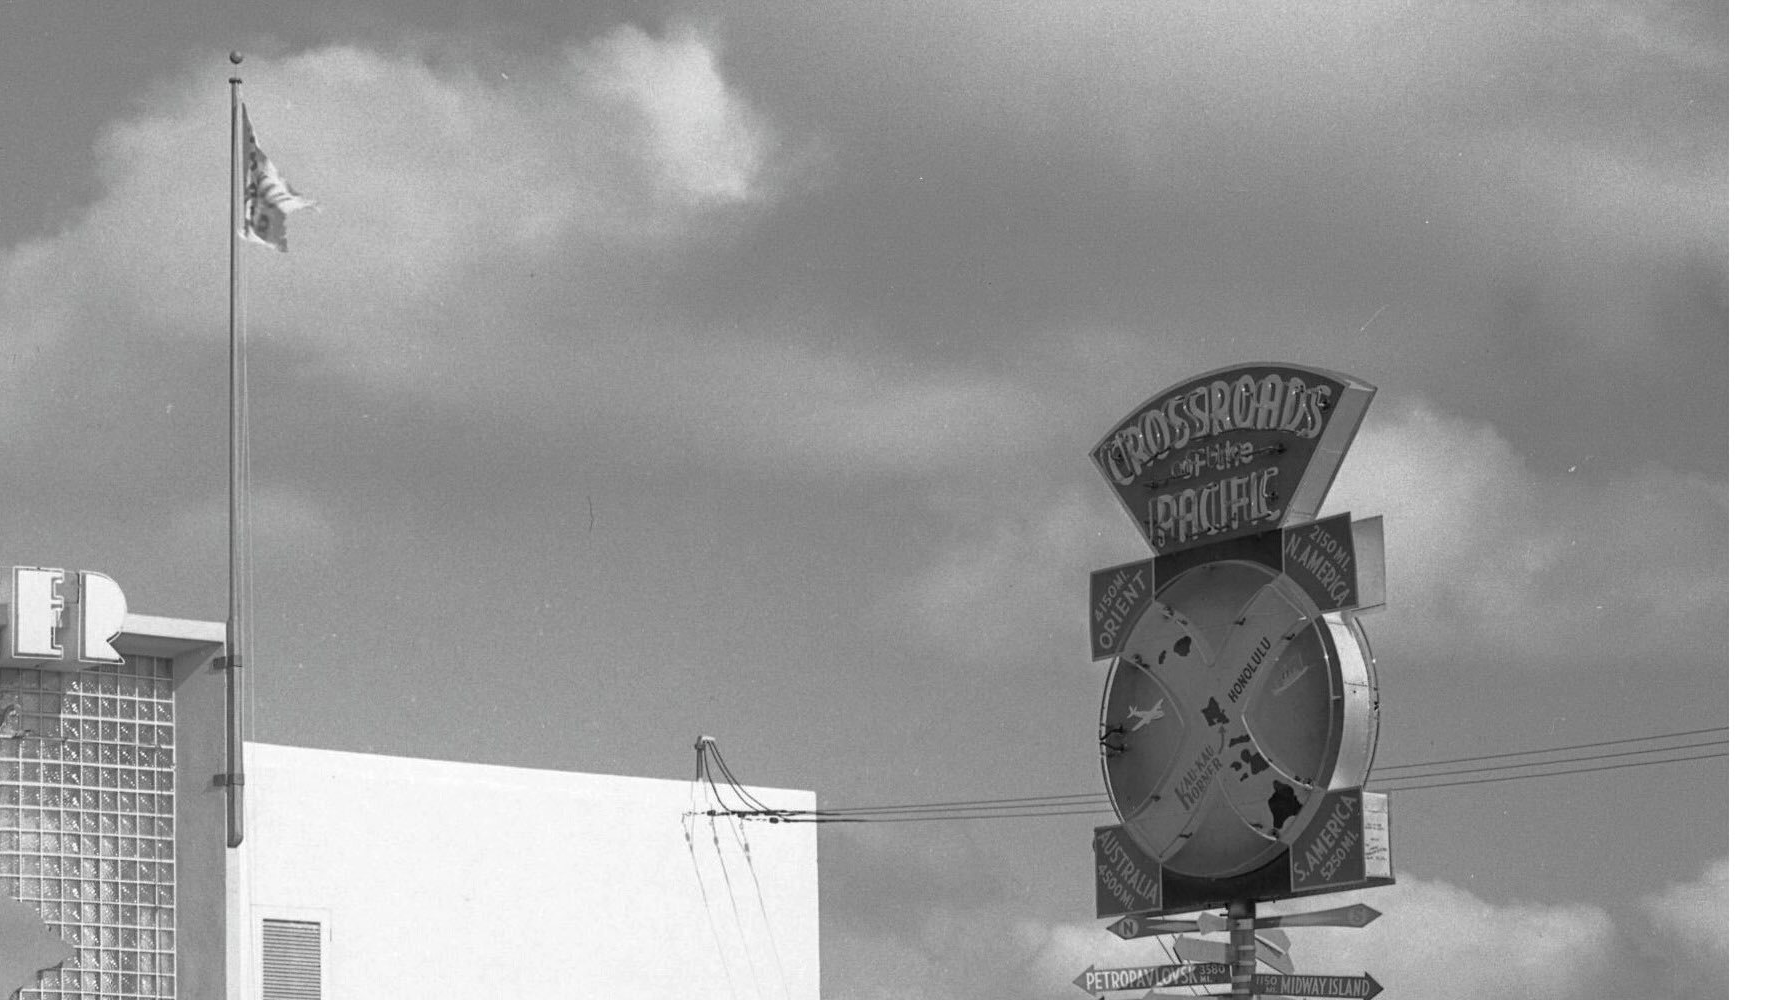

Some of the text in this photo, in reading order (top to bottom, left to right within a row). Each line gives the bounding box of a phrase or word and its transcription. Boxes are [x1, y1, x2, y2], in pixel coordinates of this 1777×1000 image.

[1100, 374, 1331, 485] CROSSROADS
[1148, 467, 1281, 547] PACIFIC
[1099, 569, 1145, 649] ORIENT
[1227, 636, 1272, 703] HONOLULU
[1097, 830, 1158, 905] AUSTRALIA
[1280, 976, 1325, 995] MIDWAY
[1328, 978, 1371, 997] ISLAND
